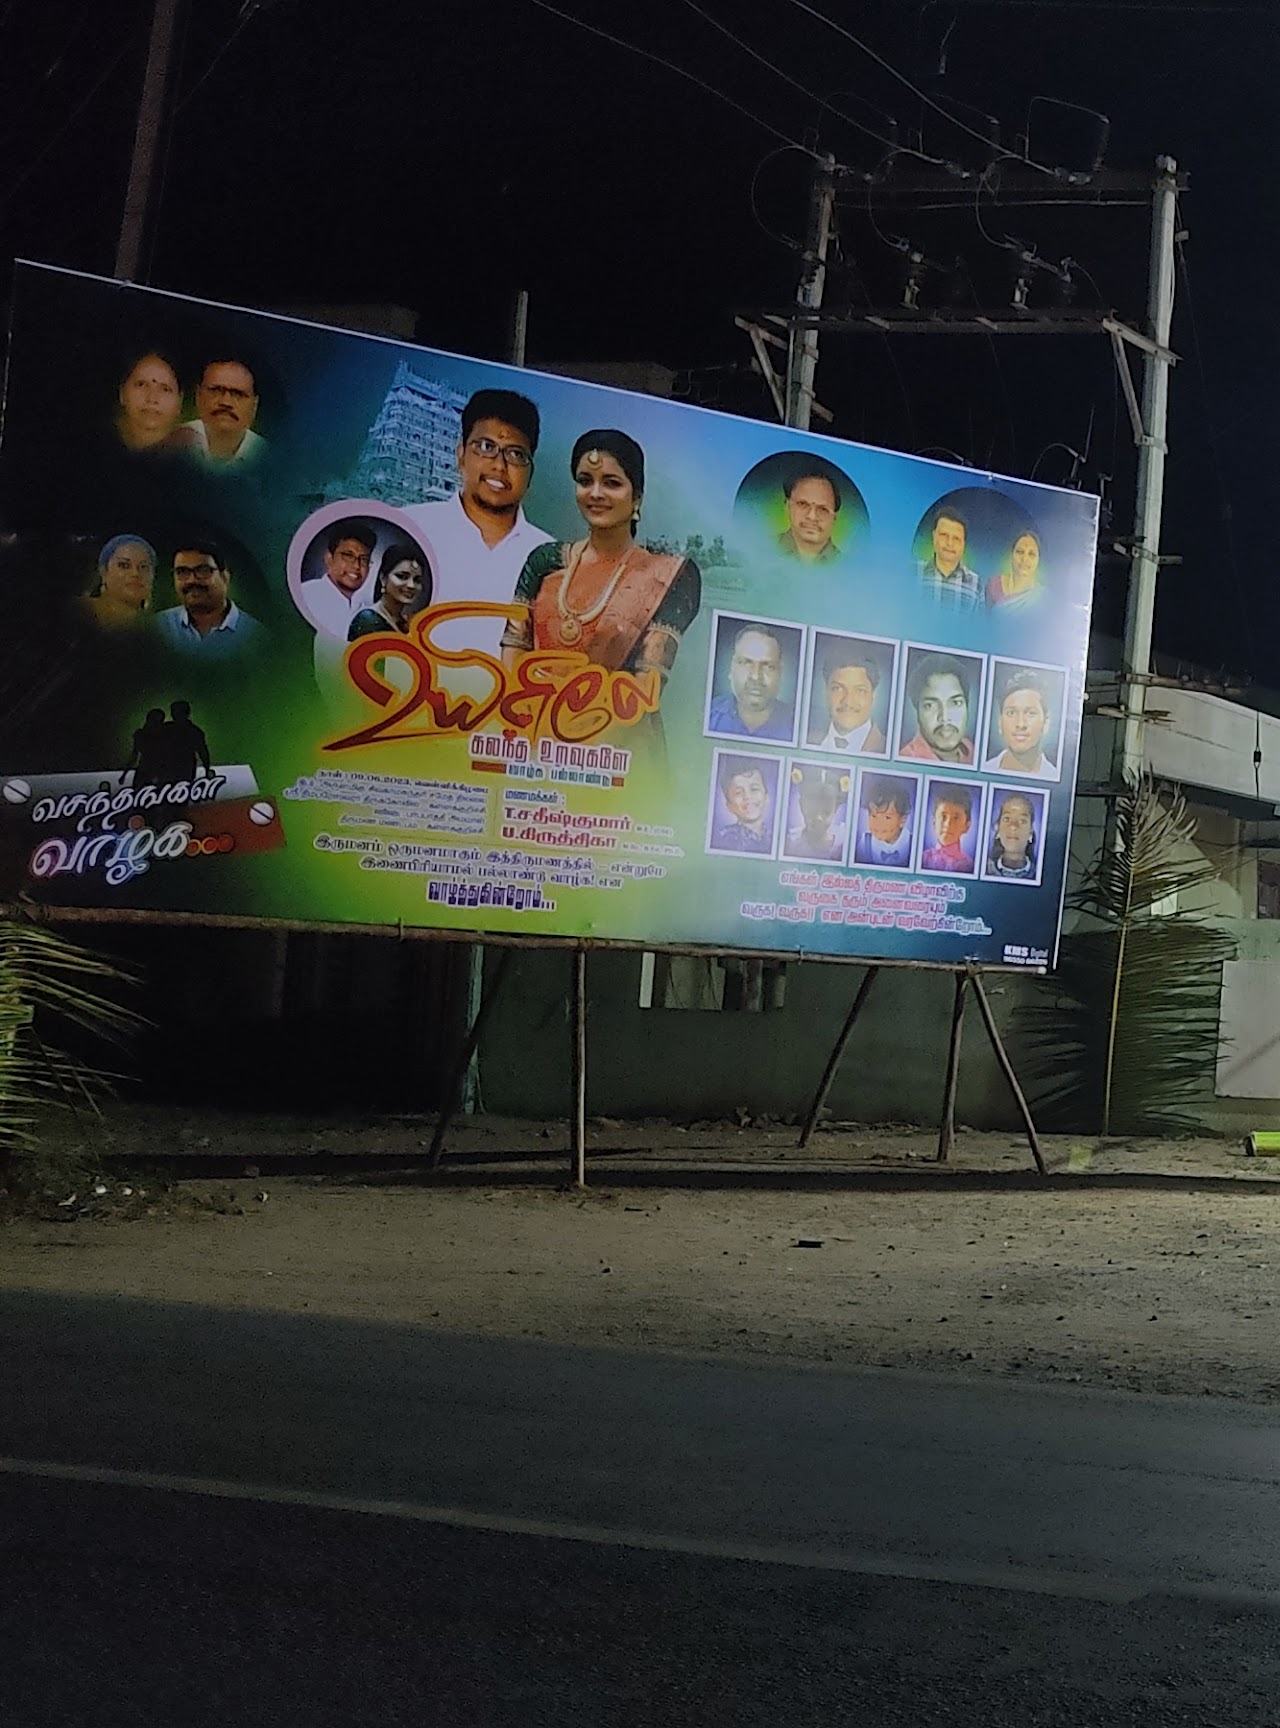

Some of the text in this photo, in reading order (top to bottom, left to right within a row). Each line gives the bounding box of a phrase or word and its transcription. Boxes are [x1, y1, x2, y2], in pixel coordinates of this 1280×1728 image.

[470, 731, 630, 772] கலந்த உறவுகளே
[505, 789, 558, 804] மணமக்கள்
[316, 834, 383, 852] இருமனம்
[478, 864, 546, 883] பல்லாண்டு
[599, 876, 622, 888] என
[822, 910, 843, 922] என
